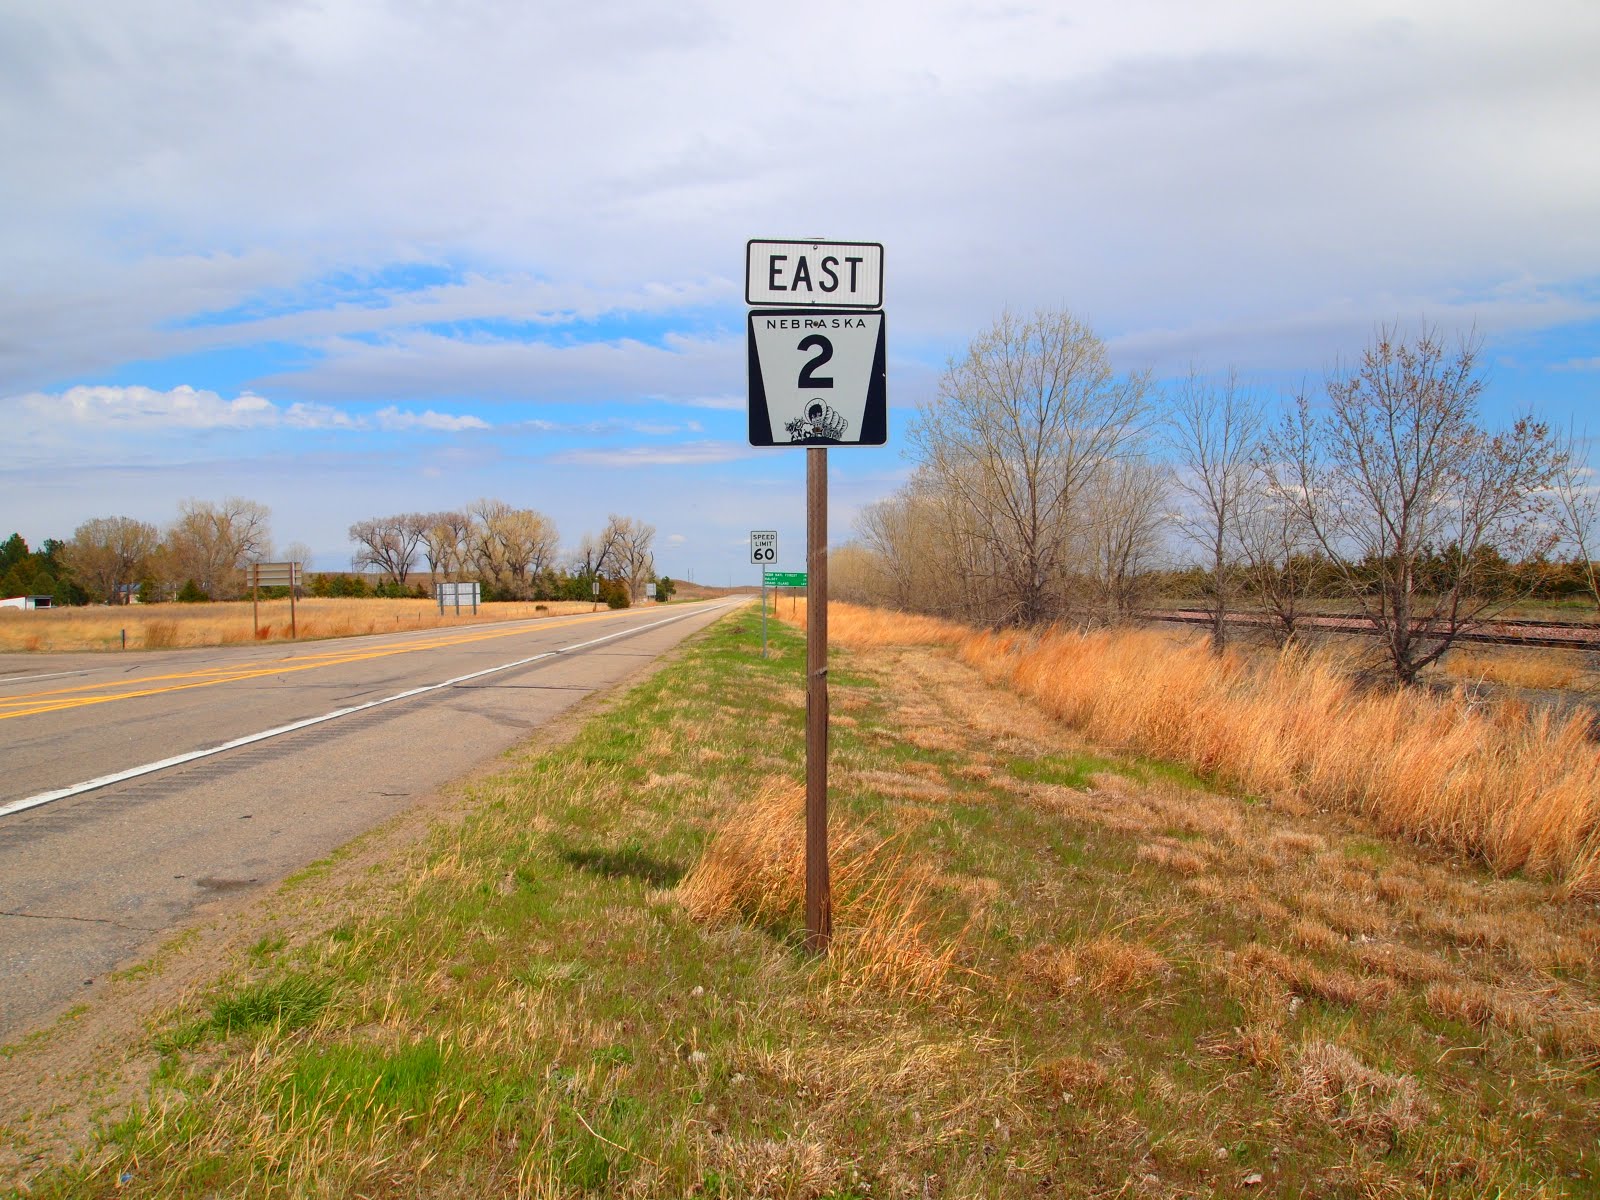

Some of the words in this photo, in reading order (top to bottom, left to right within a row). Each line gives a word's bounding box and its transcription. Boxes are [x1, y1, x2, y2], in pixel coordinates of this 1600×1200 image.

[769, 255, 863, 292] EAST
[767, 319, 866, 329] NEBRASKA
[797, 334, 834, 388] 2
[754, 548, 774, 560] 60
